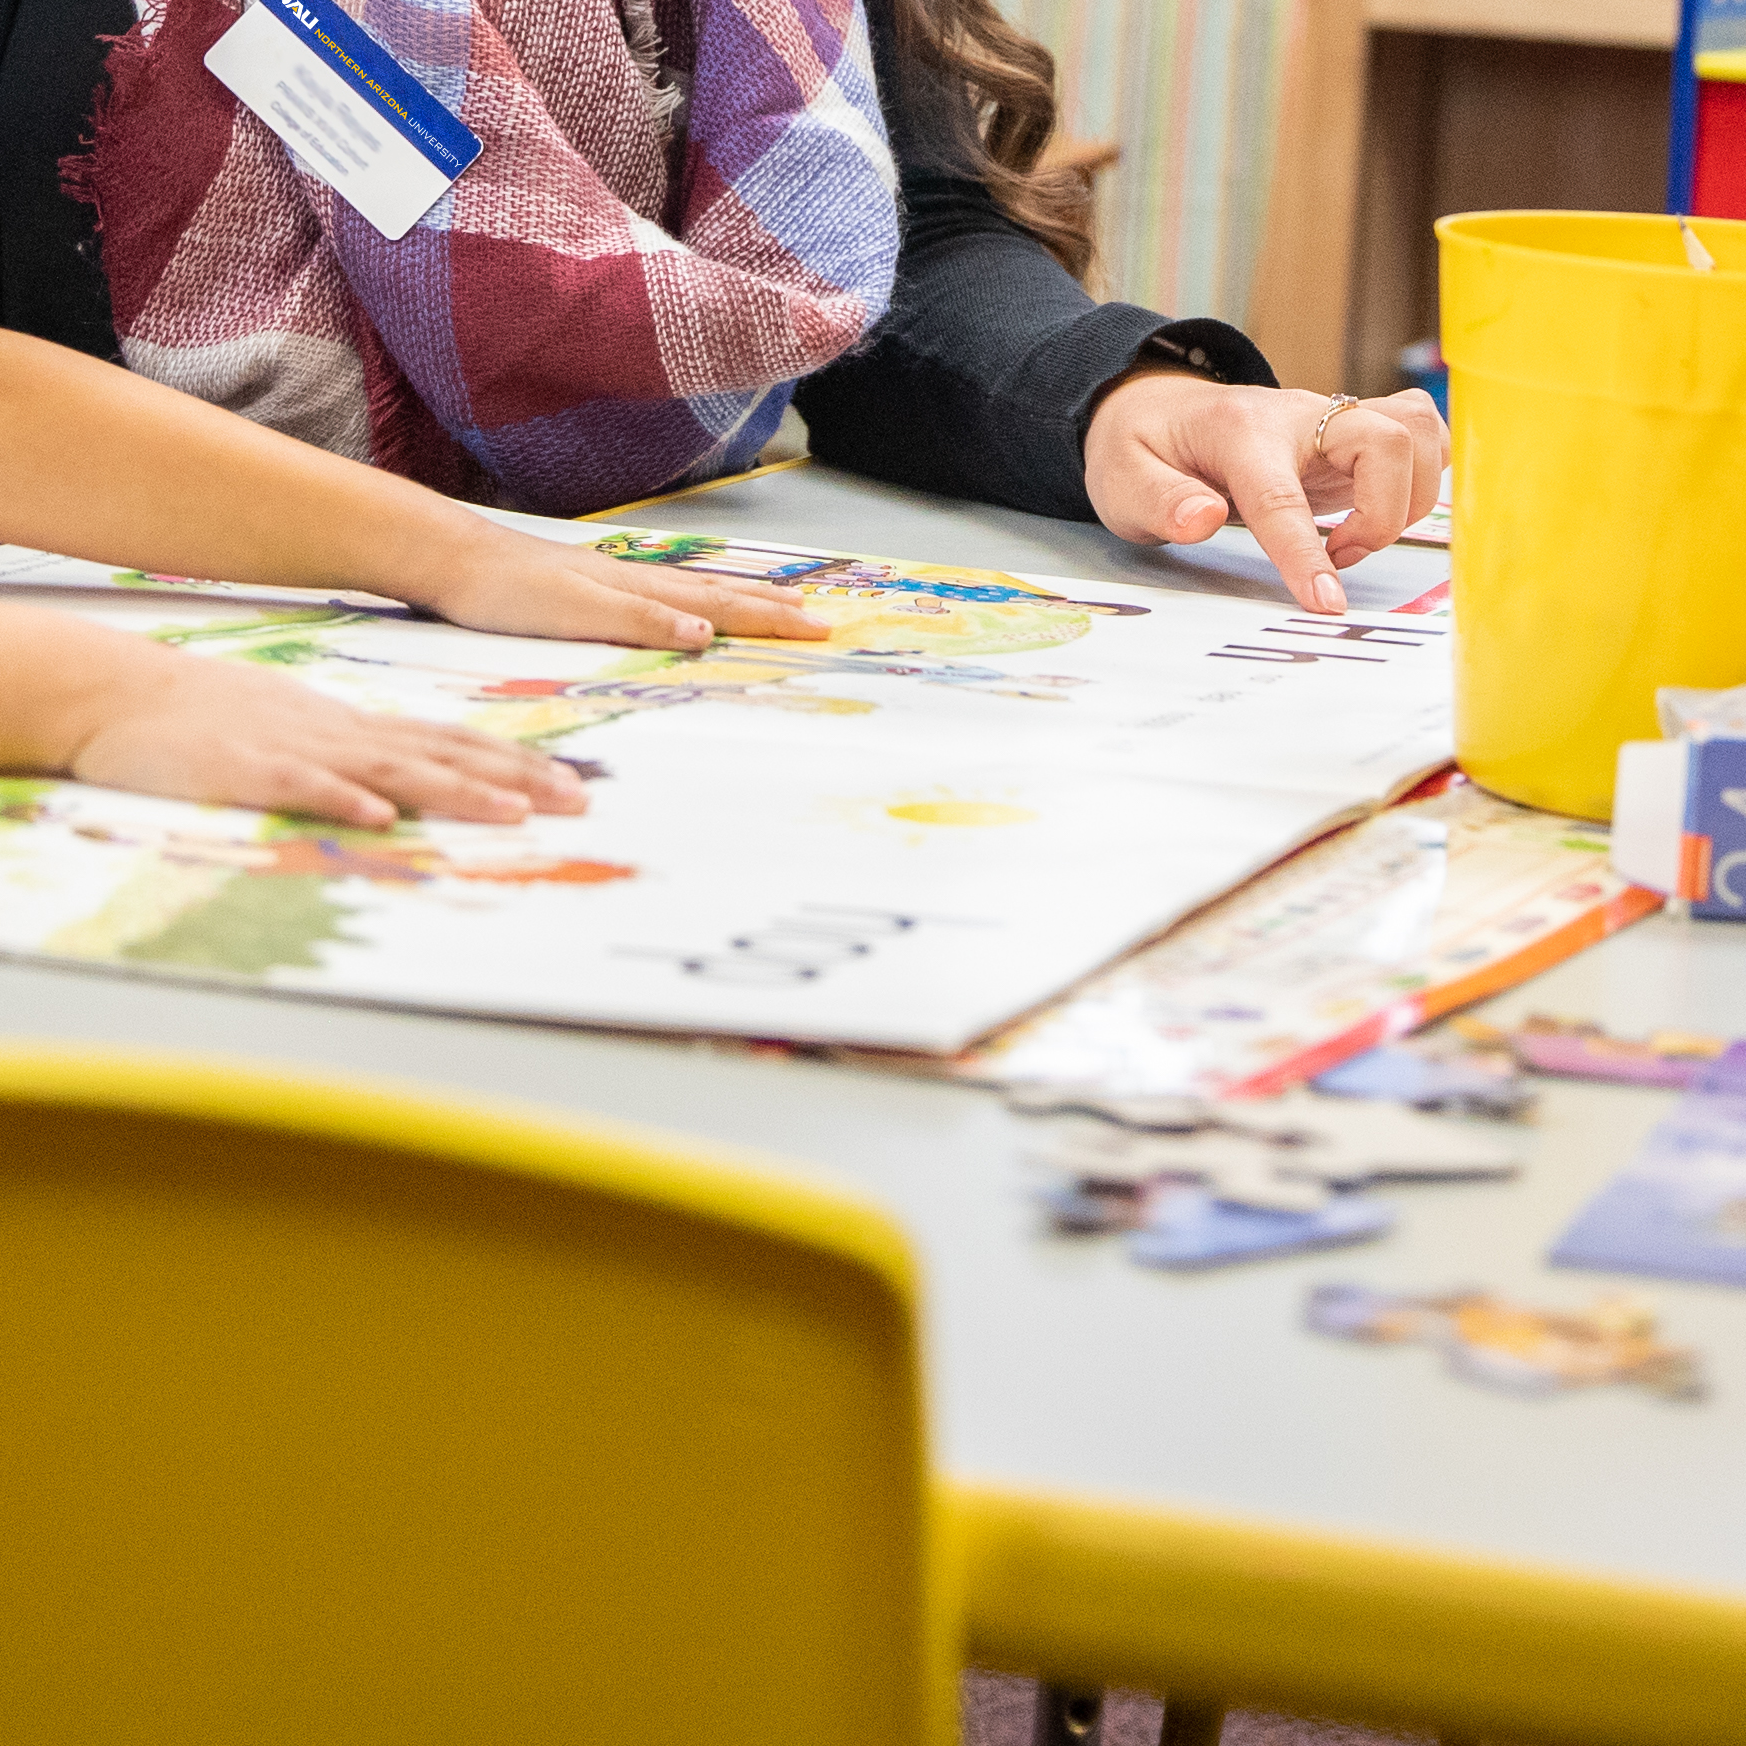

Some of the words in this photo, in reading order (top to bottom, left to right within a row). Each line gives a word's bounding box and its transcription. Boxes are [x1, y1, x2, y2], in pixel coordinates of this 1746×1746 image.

[314, 28, 367, 80] NORTHERN
[366, 79, 408, 120] ARIZONA
[407, 117, 462, 168] UNIVERSITY
